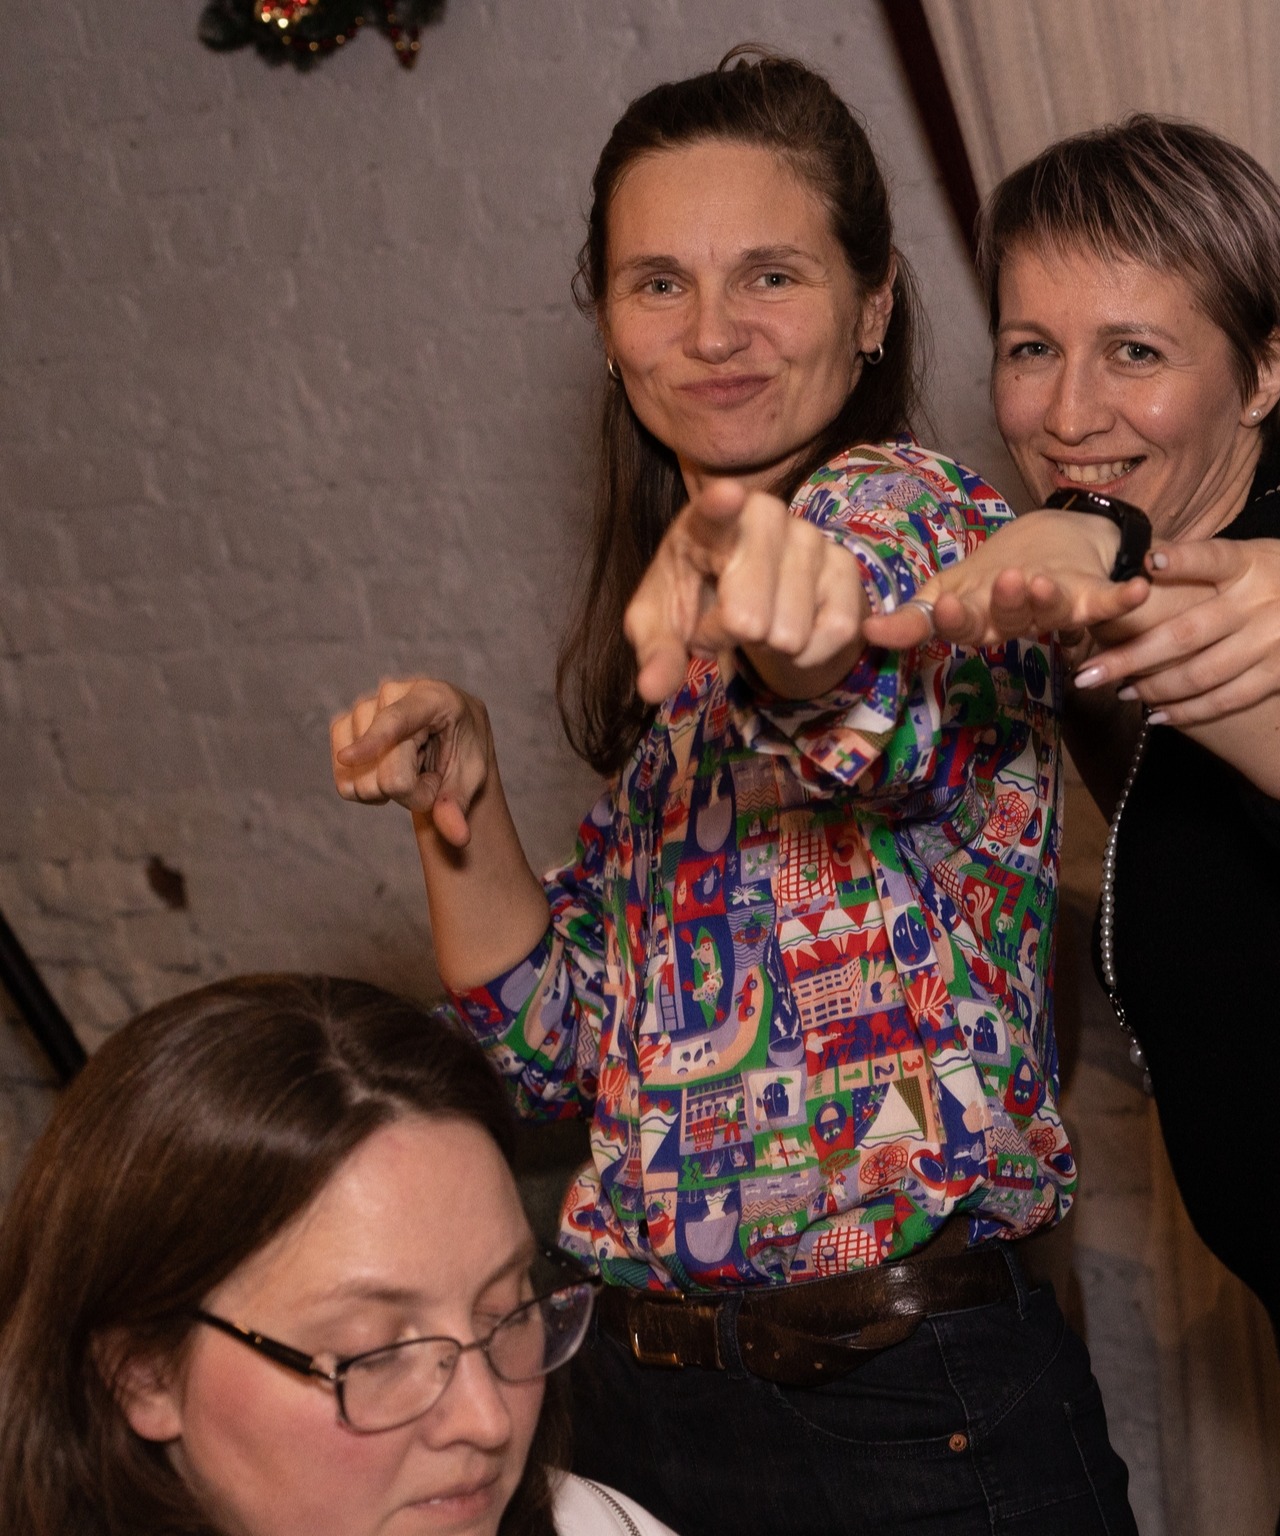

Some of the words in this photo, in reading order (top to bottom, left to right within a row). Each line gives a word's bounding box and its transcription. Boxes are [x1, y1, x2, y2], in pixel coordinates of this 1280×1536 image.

[843, 1068, 863, 1081] 1
[874, 1062, 895, 1079] 2
[902, 1055, 923, 1072] 3
